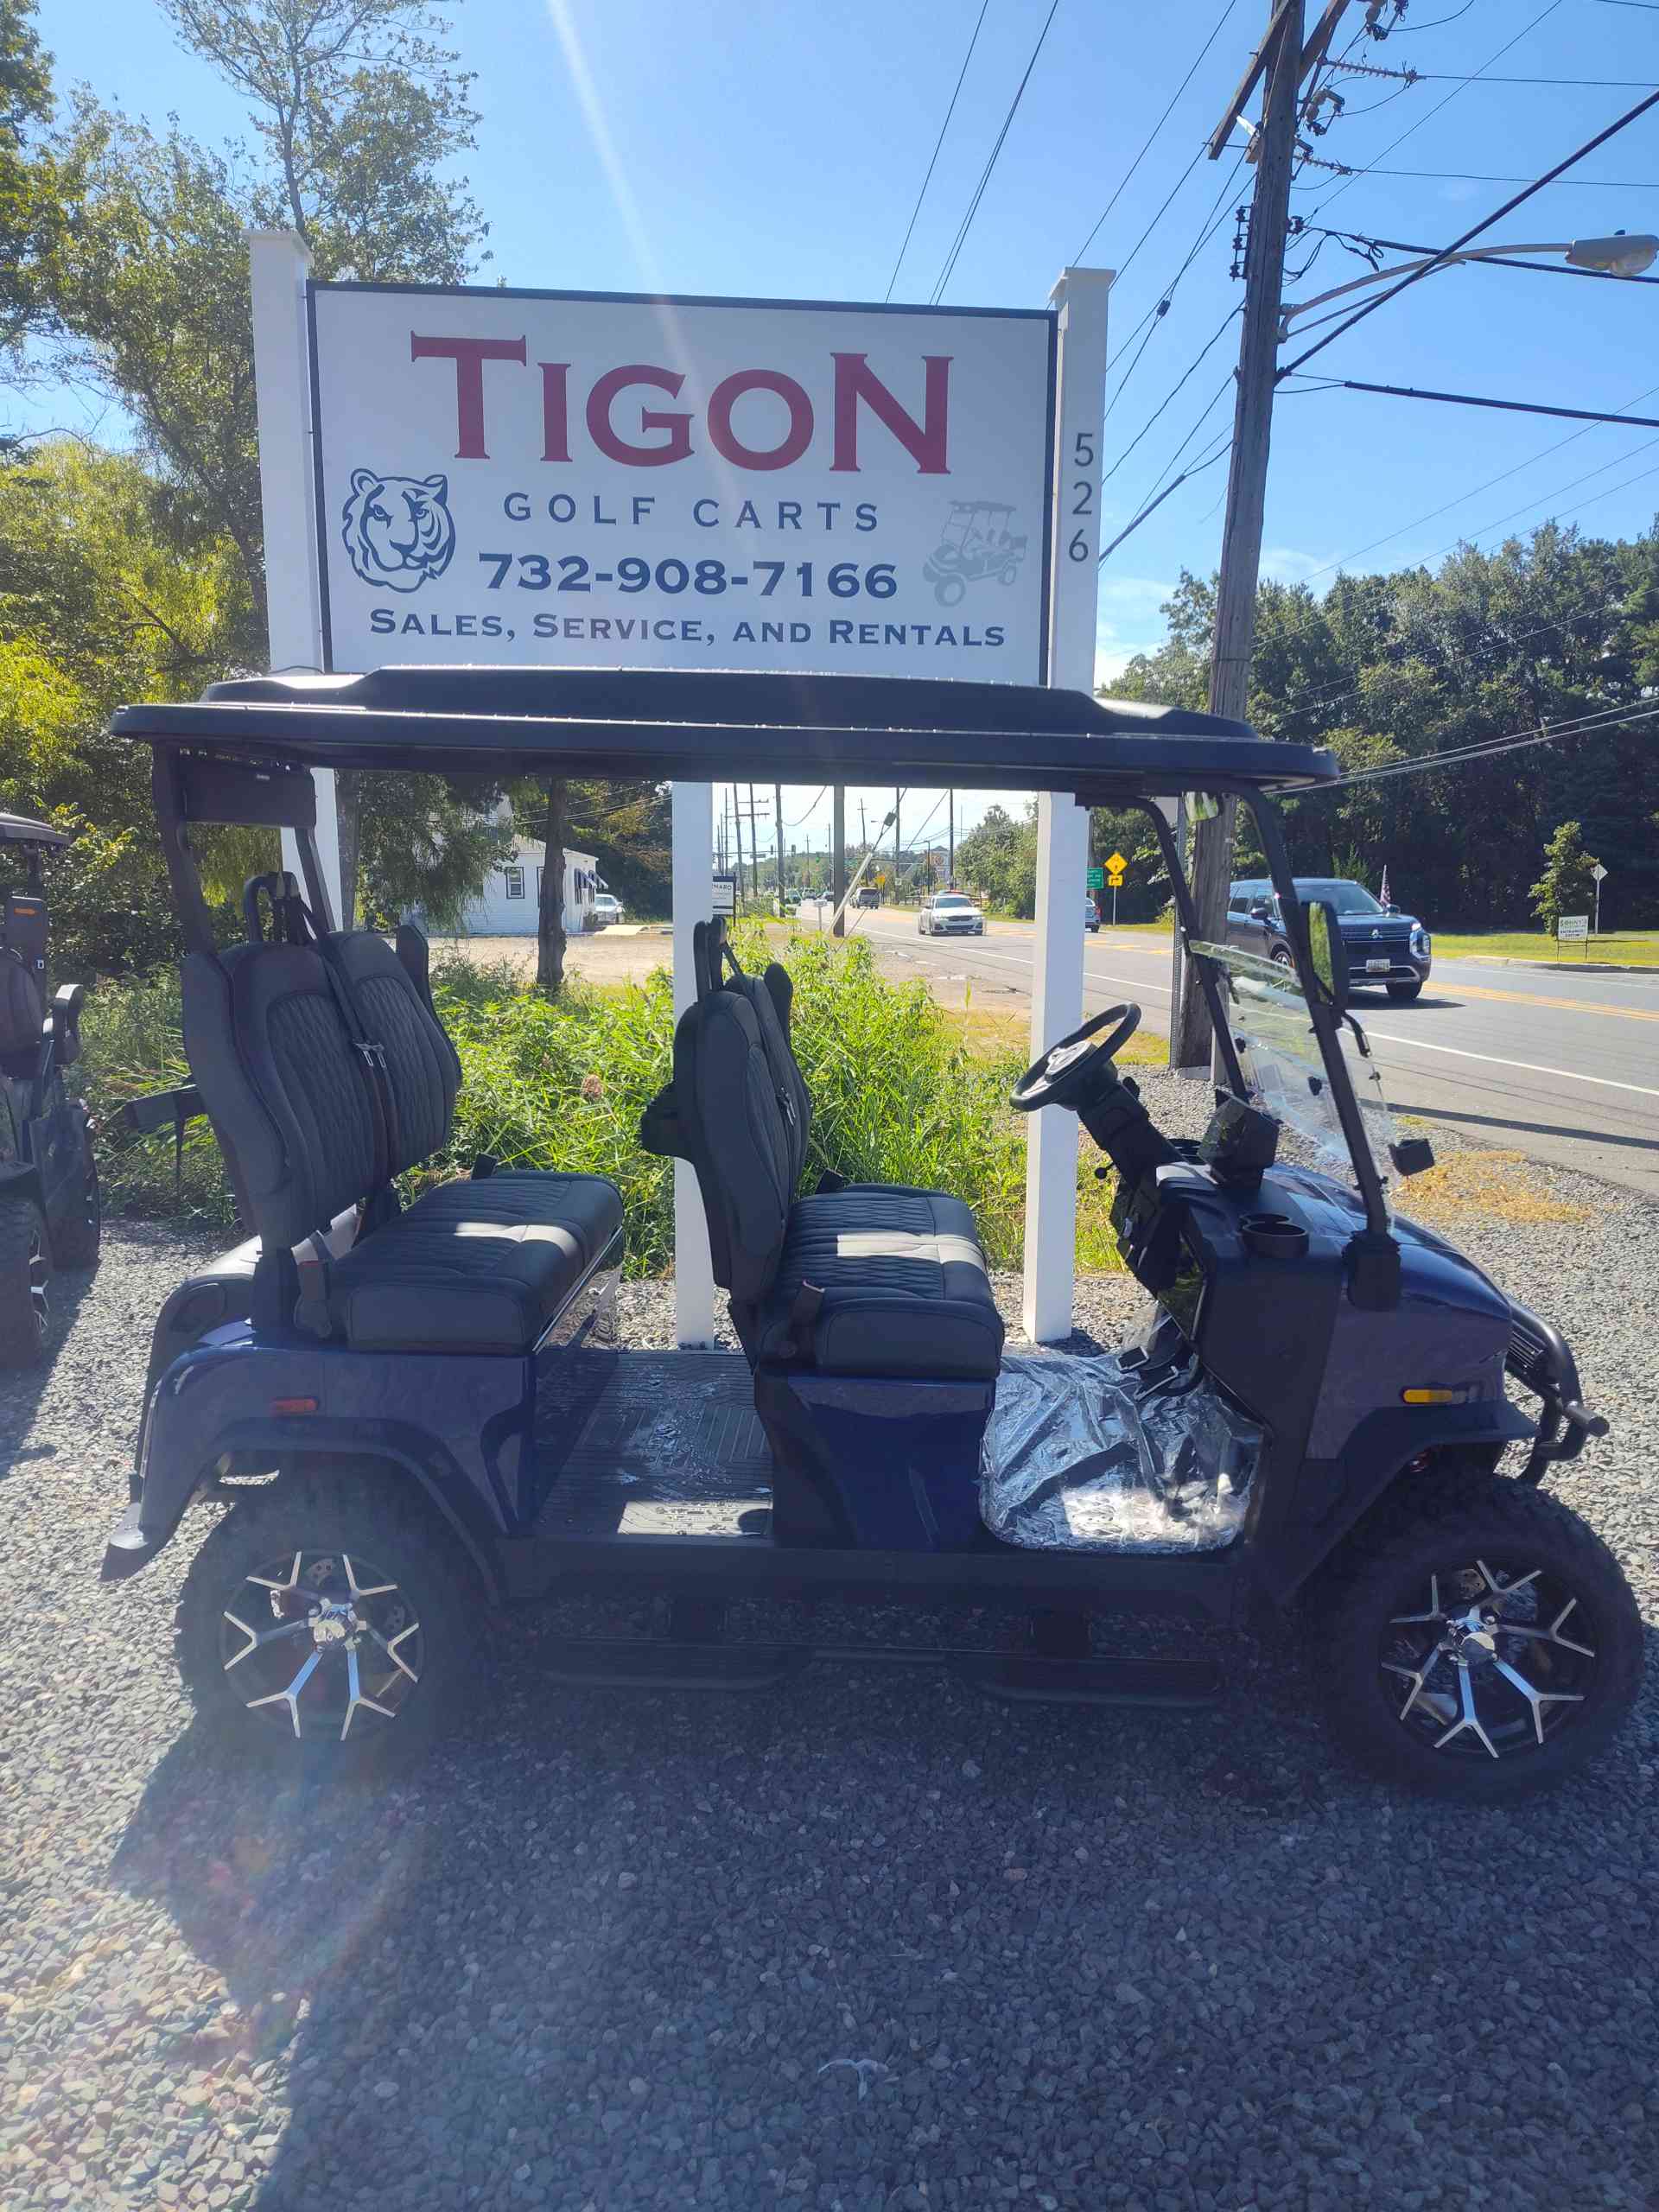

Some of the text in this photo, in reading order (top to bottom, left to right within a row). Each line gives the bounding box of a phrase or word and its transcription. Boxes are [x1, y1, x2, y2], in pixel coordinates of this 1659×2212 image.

[410, 330, 955, 475] TIGON
[503, 492, 880, 532] GOLF CARTS
[479, 552, 898, 599] 732-908-7166
[370, 608, 1005, 647] SALES, SERVICE, AND RENTALS
